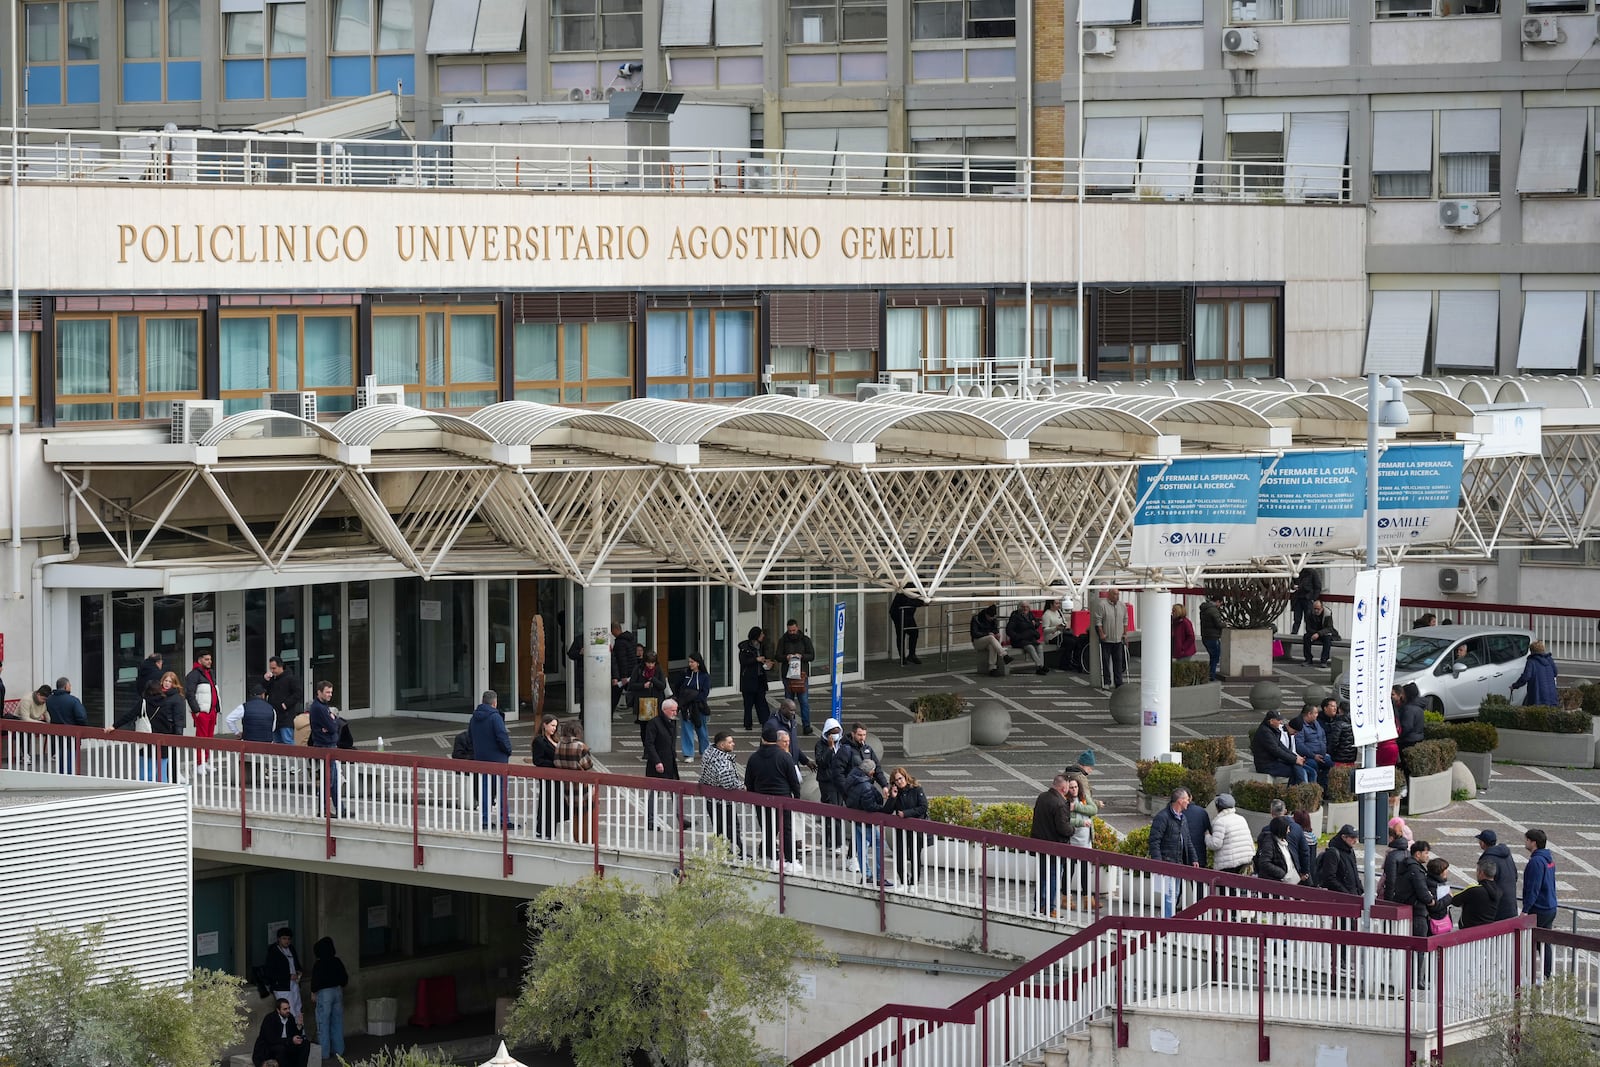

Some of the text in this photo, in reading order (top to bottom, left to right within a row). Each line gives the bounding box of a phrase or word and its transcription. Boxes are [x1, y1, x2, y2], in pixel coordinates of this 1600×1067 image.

[119, 224, 954, 265] POLICLINICO UNIVERSITARIO AGOSTINO GEMELLI
[1332, 467, 1358, 476] CURA,
[1378, 532, 1405, 540] emelli
[1273, 540, 1308, 549] Gemelli
[1164, 548, 1200, 558] Gemelli
[1354, 640, 1365, 728] Gemelli
[1378, 636, 1387, 723] Gemelli
